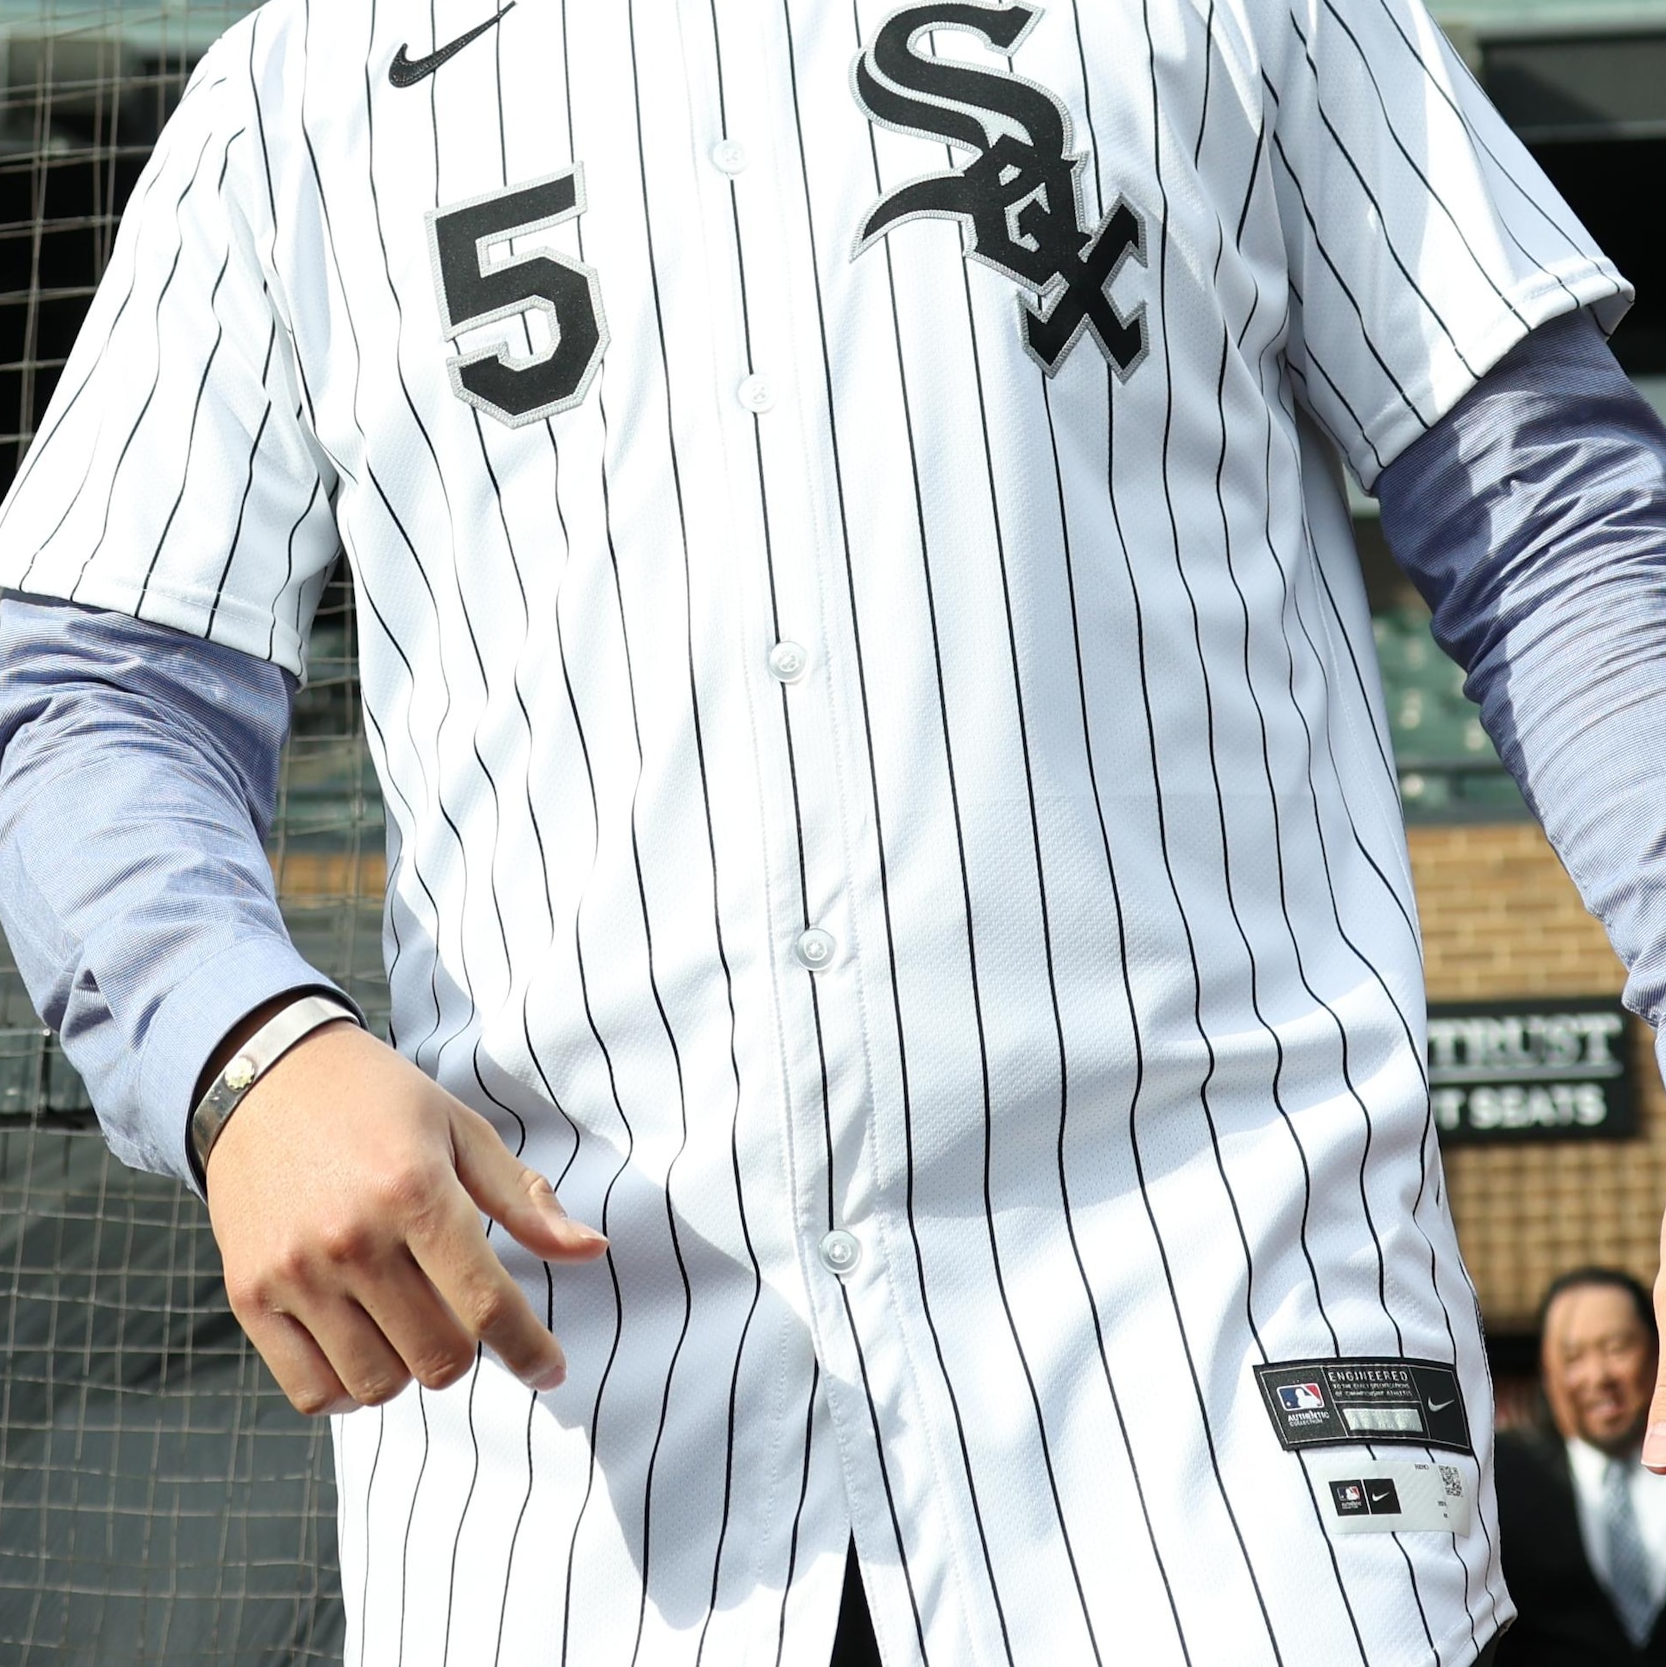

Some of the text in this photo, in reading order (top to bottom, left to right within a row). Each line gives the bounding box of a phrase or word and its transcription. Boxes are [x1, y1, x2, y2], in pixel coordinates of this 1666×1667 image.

[423, 159, 612, 430] 5
[1469, 1084, 1608, 1130] SEATS
[1327, 1370, 1409, 1382] ENGINEERED
[1287, 1410, 1330, 1423] AUTHENTIC
